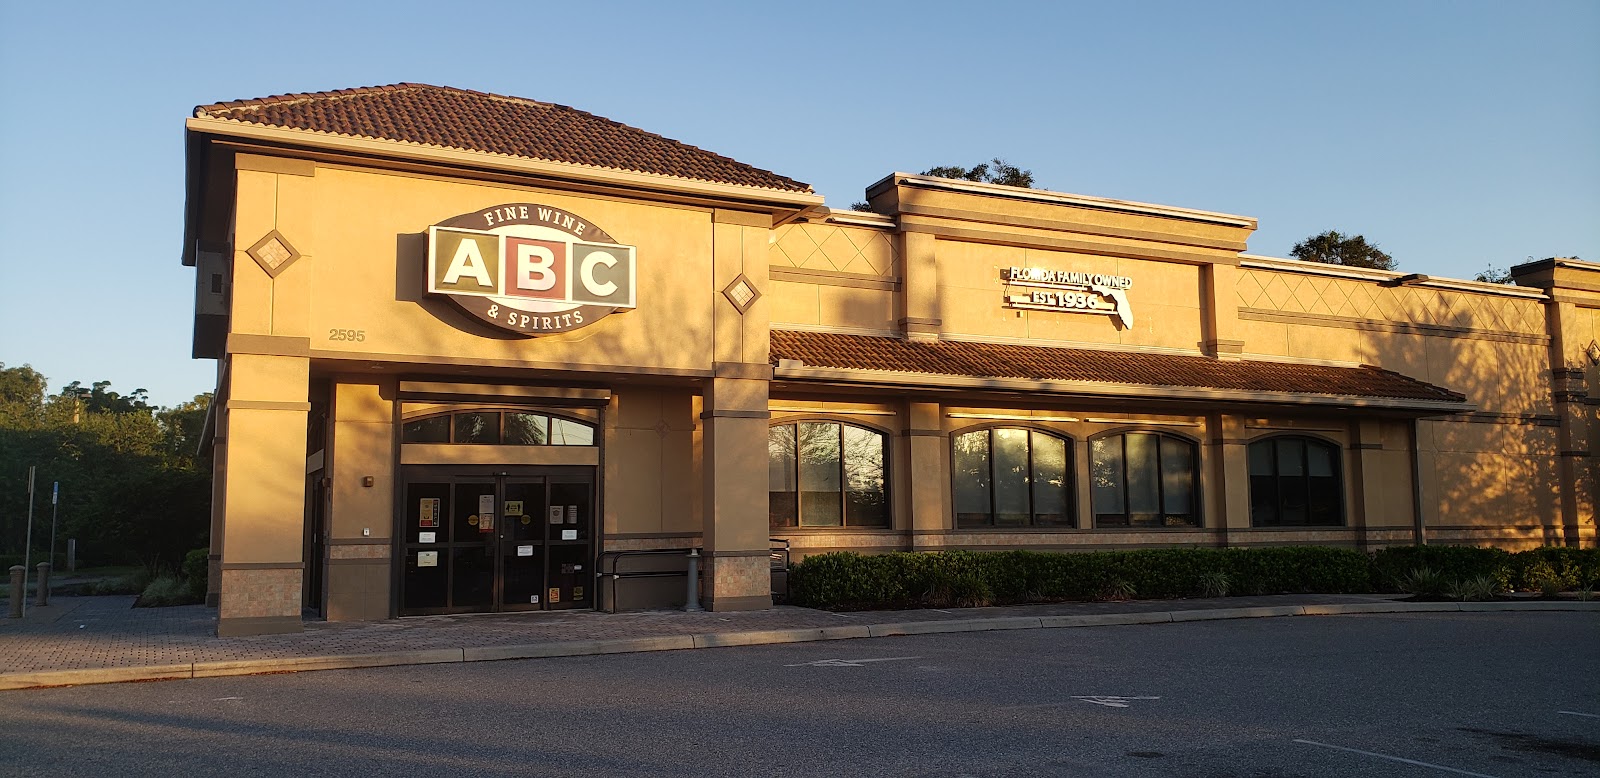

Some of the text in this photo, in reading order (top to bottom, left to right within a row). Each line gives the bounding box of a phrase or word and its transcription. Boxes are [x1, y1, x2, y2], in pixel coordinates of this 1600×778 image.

[484, 206, 586, 236] FINE WINE
[441, 238, 619, 297] ABC
[1056, 271, 1093, 286] FAMILY
[1093, 274, 1133, 289] OWNED
[1055, 291, 1099, 309] 1936
[487, 304, 584, 330] & SPIRITS
[328, 328, 366, 342] 2595
